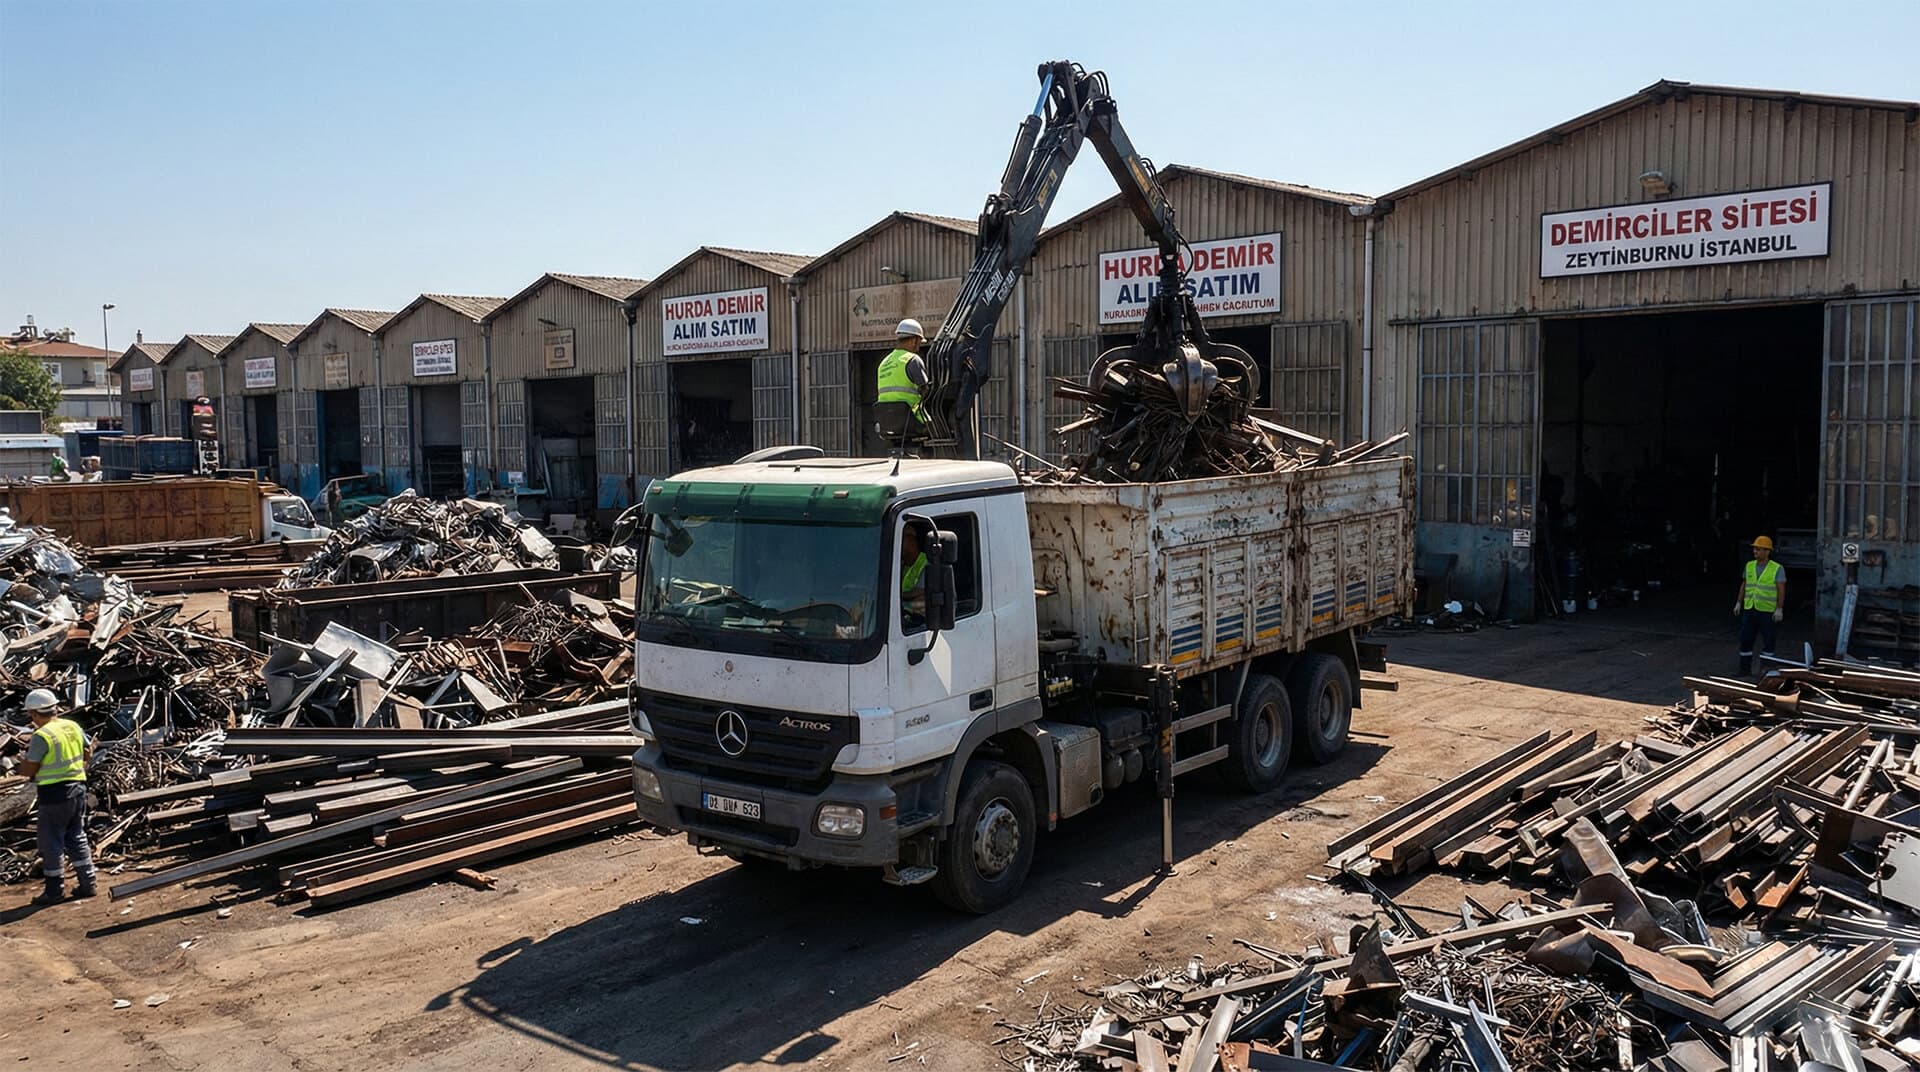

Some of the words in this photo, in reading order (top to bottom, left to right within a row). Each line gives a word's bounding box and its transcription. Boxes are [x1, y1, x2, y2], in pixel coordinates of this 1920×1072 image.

[1551, 207, 1712, 247] DEMİRCİLER
[1721, 190, 1817, 231] SİTESİ
[1193, 239, 1275, 272] DEMİR
[1565, 243, 1694, 269] ZEYTİNBURNU
[1700, 234, 1797, 259] İSTANBUL
[1184, 272, 1260, 298] SATIM
[665, 299, 713, 321] HURDA
[717, 291, 765, 316] DEMİR
[673, 321, 706, 340] ALIM
[711, 317, 756, 337] SATIM
